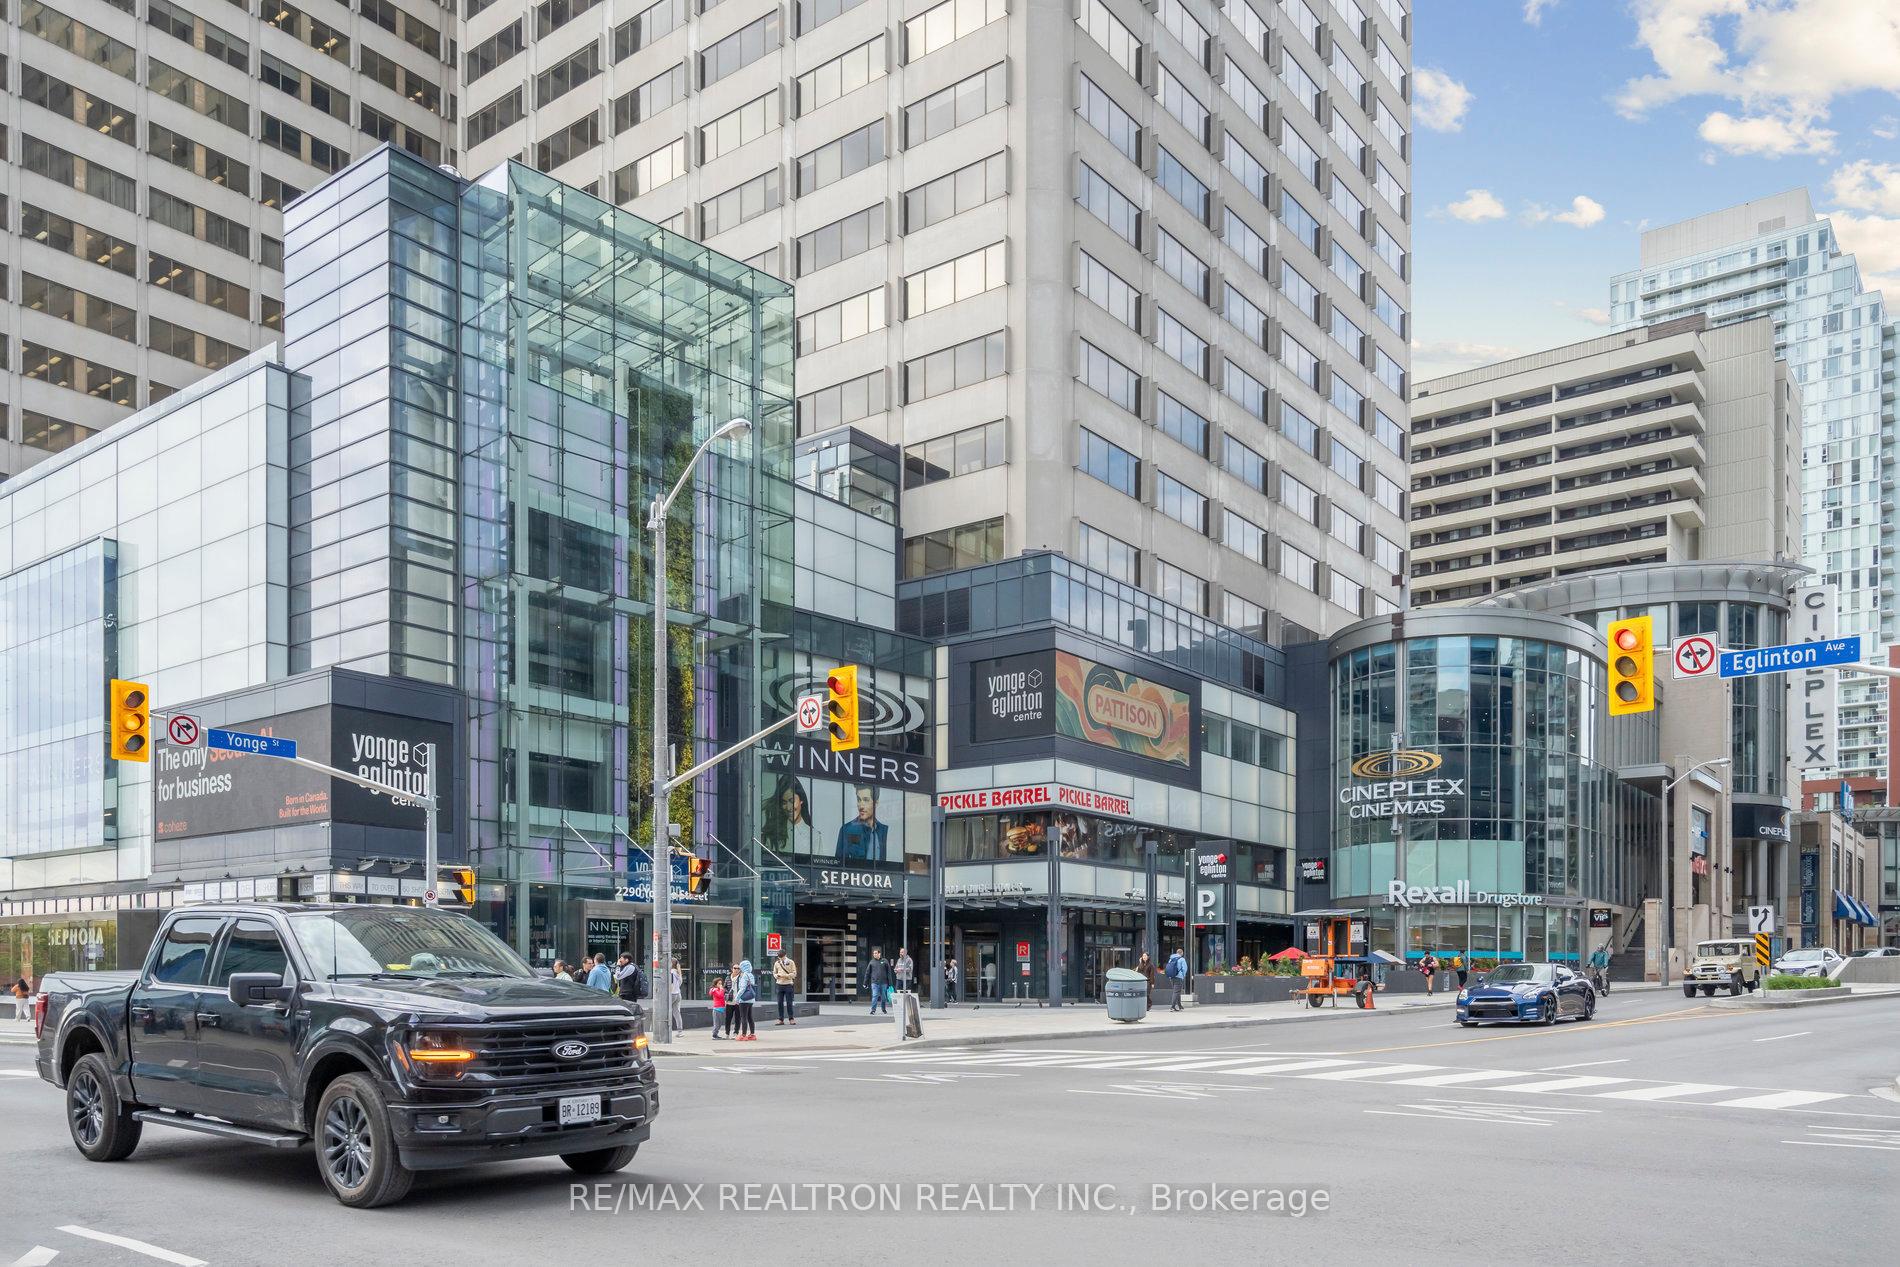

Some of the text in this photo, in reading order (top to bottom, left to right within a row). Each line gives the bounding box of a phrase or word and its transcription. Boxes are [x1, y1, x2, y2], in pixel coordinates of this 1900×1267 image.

[1733, 641, 1846, 673] Eglinton Ave
[988, 671, 1025, 698] yonge
[992, 691, 1043, 718] eglinton
[1095, 694, 1157, 729] PATTISON
[1013, 711, 1042, 722] centre
[226, 733, 280, 752] Yonge St
[352, 733, 409, 767] yonge
[158, 748, 180, 771] The
[182, 746, 208, 770] only
[762, 740, 920, 784] WINNERS
[158, 772, 232, 801] for business
[1340, 779, 1465, 804] CINEPLEX
[285, 794, 299, 805] Born
[305, 790, 328, 803] Canada.
[940, 787, 1051, 810] PICKLE BARREL
[1058, 787, 1131, 815] PICKLE BARREL
[279, 803, 328, 818] Built for the World.
[1350, 800, 1446, 819] CINEMAS
[1759, 826, 1790, 837] CINEPLE
[1198, 854, 1218, 866] yonge
[1301, 861, 1317, 870] yonge
[821, 870, 892, 889] SEPHORA
[1200, 864, 1227, 876] eglinton
[615, 886, 641, 898] 2290
[1388, 880, 1543, 908] Rexall Drugstore
[1197, 889, 1216, 917] P
[48, 927, 104, 947] SEPHORA
[770, 938, 778, 948] R
[1020, 945, 1027, 955] R
[562, 1045, 582, 1056] Ford
[562, 1102, 600, 1118] BR 12189
